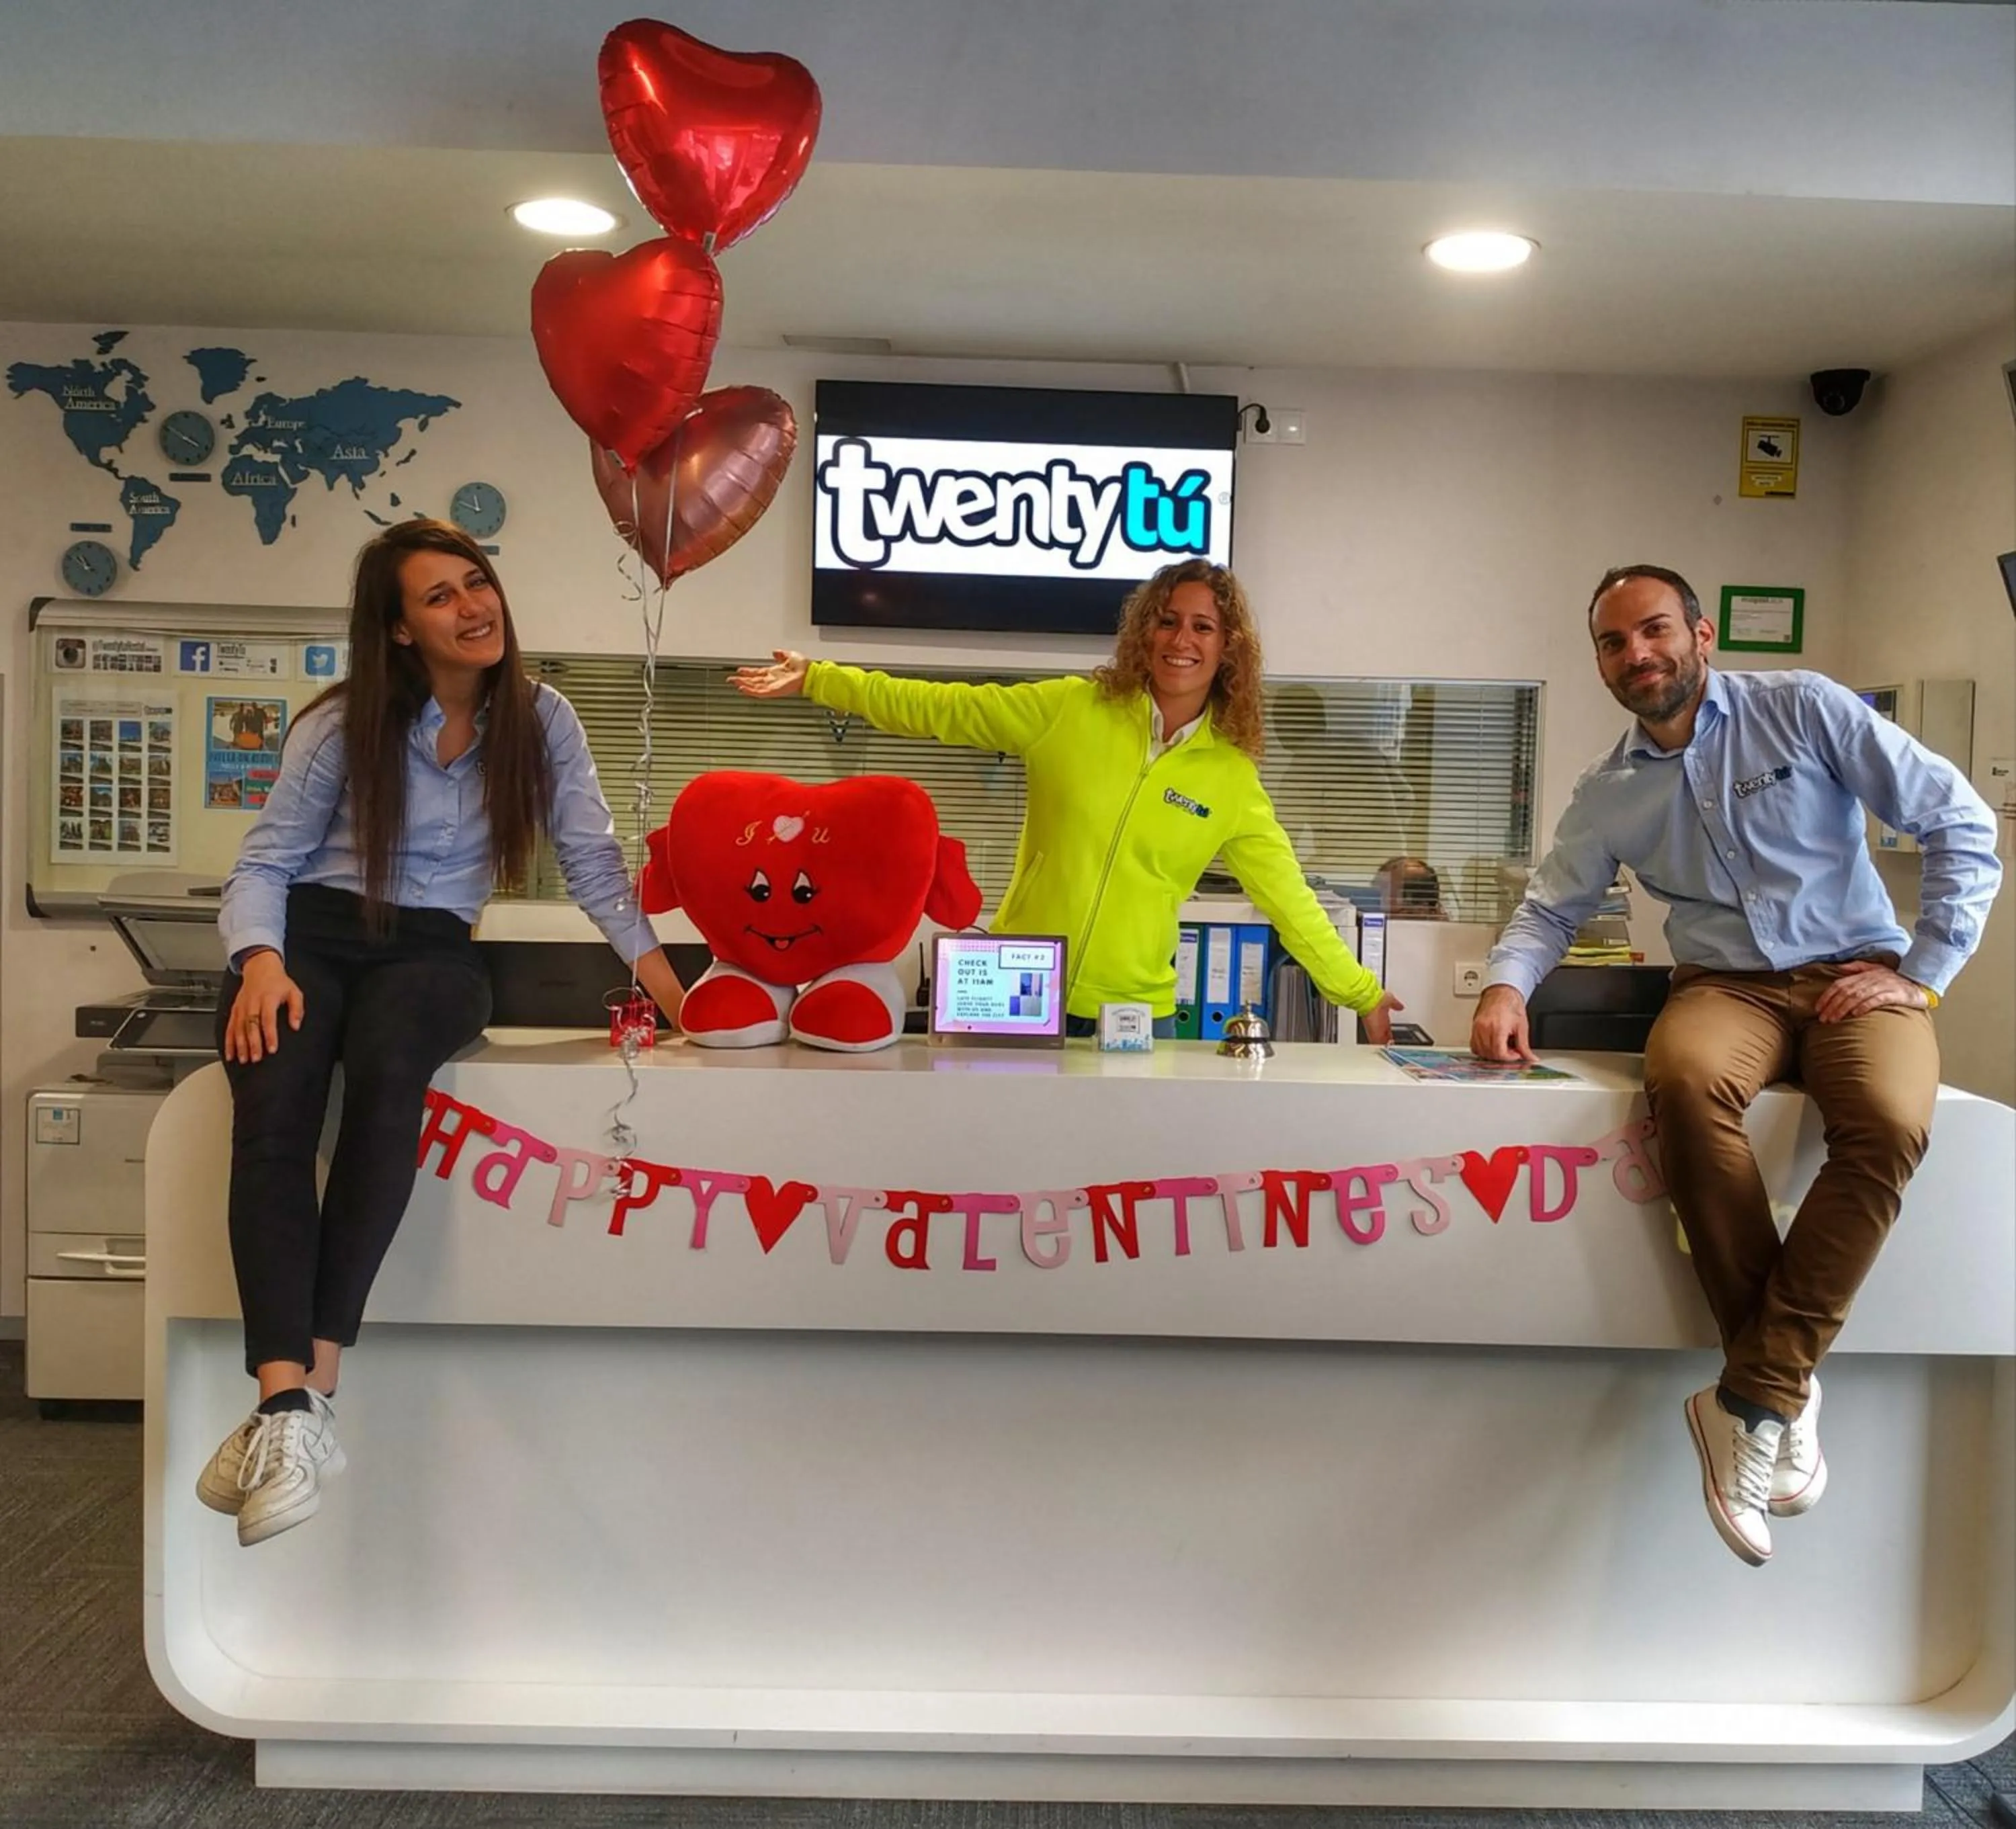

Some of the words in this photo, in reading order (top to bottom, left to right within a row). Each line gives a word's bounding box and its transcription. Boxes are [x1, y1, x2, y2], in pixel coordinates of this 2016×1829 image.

[266, 416, 306, 431] Europe
[330, 443, 369, 460] Asia
[232, 471, 278, 486] Africa
[1011, 953, 1031, 961] FACT
[958, 959, 987, 967] CHECK
[958, 968, 976, 976] OUT
[979, 968, 988, 976] IS
